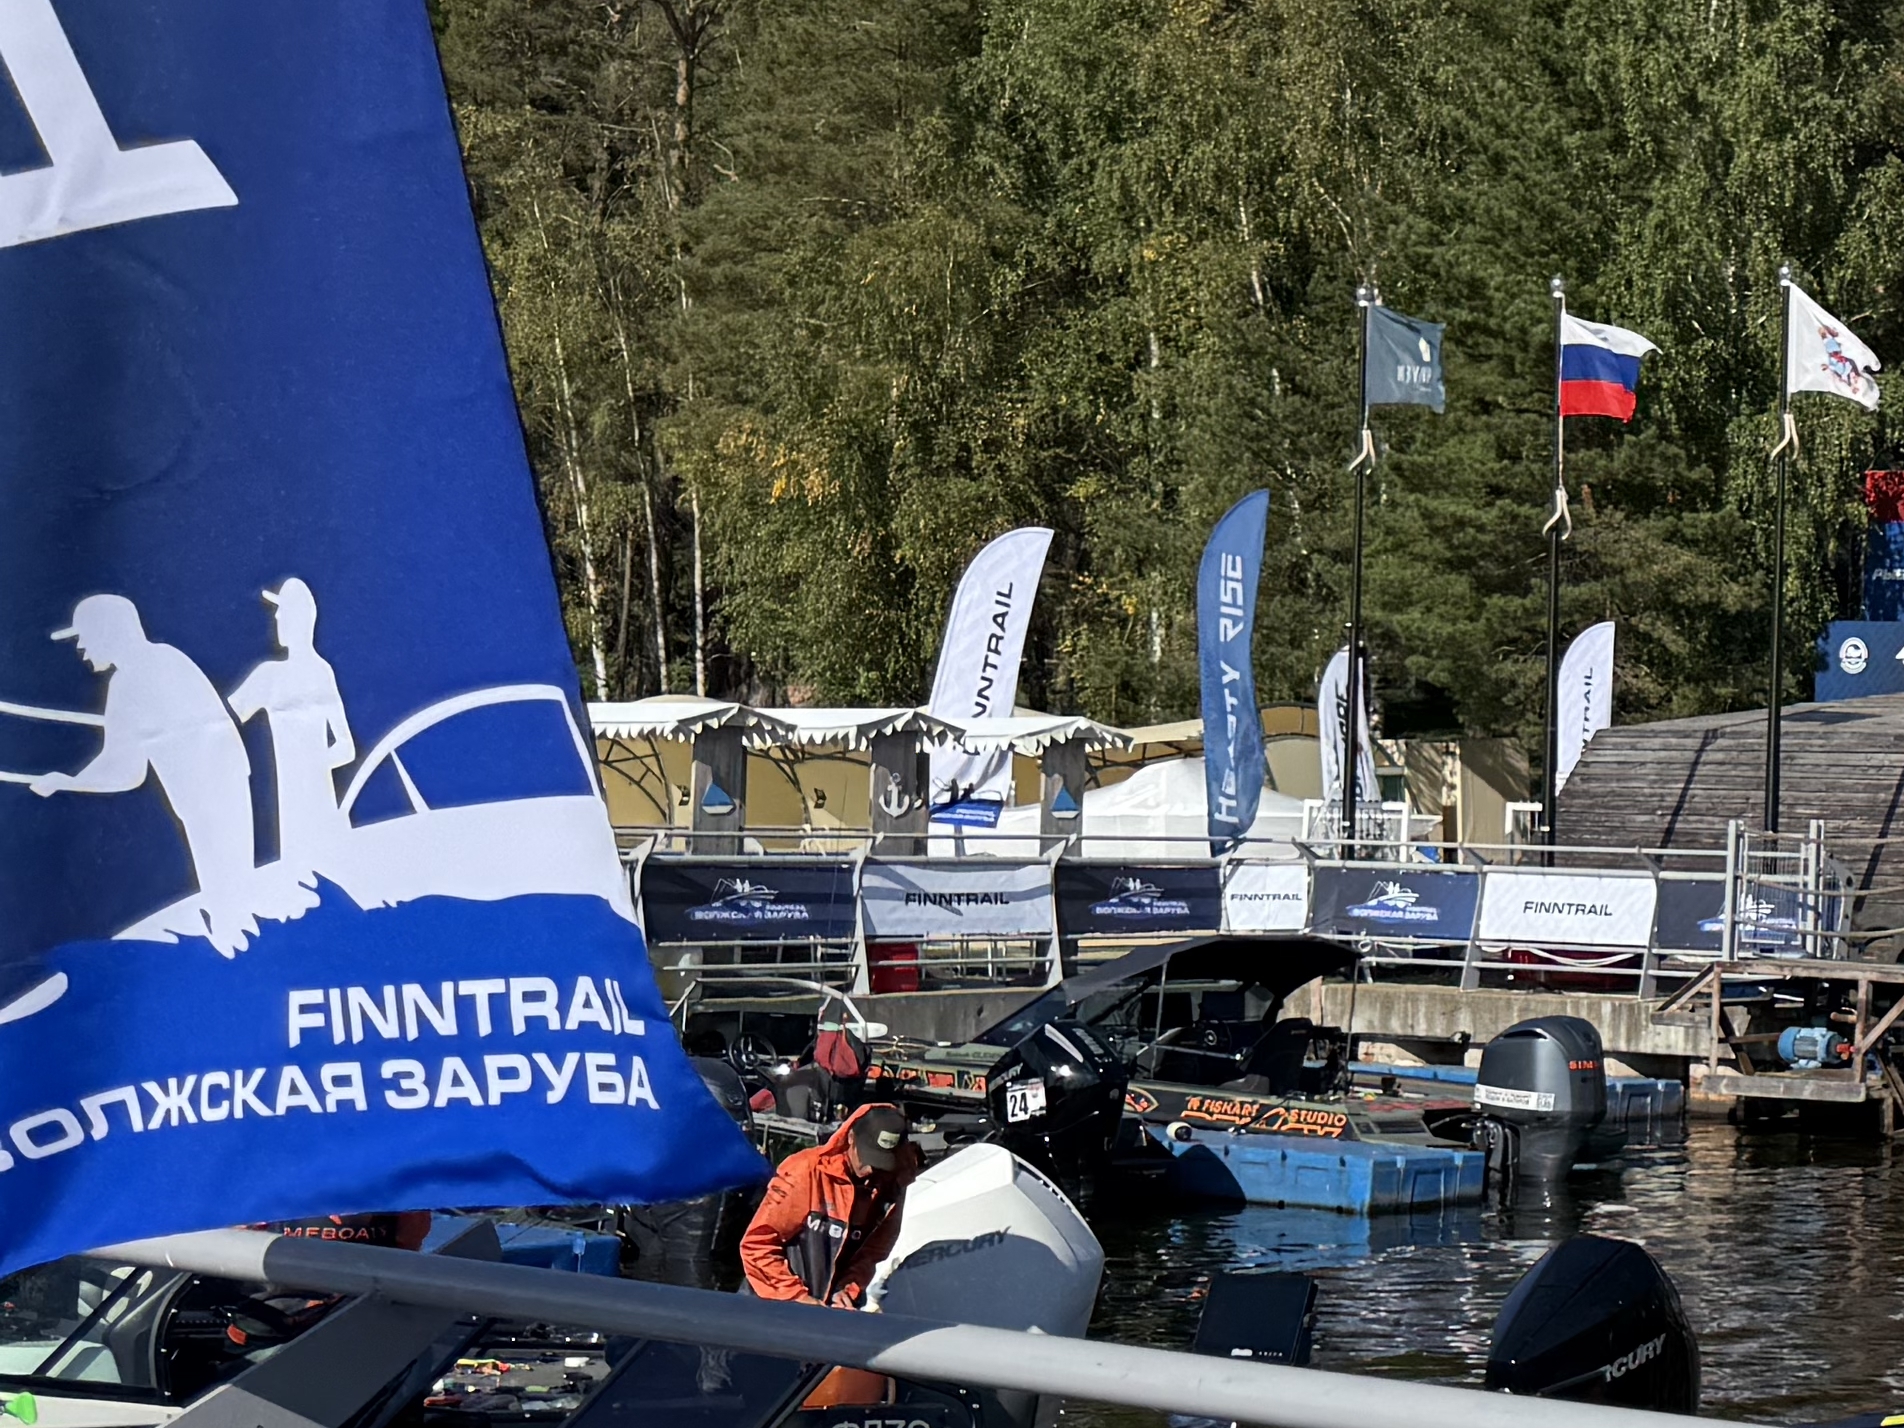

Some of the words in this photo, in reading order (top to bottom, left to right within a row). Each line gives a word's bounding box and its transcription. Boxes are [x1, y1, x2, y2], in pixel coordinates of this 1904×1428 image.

[1218, 552, 1245, 644] RISE
[903, 891, 1011, 907] FINNTRAIL
[1230, 892, 1303, 903] FINNTRAIL
[1522, 900, 1613, 917] FINNTRAIL
[287, 976, 646, 1048] FINNTRAIL
[0, 1061, 368, 1172] ОЛЖСКАЯ
[382, 1052, 660, 1111] ЗАРУБА
[1008, 1090, 1029, 1118] 24
[1202, 1098, 1262, 1118] FISKART
[1289, 1107, 1348, 1128] STUDIO
